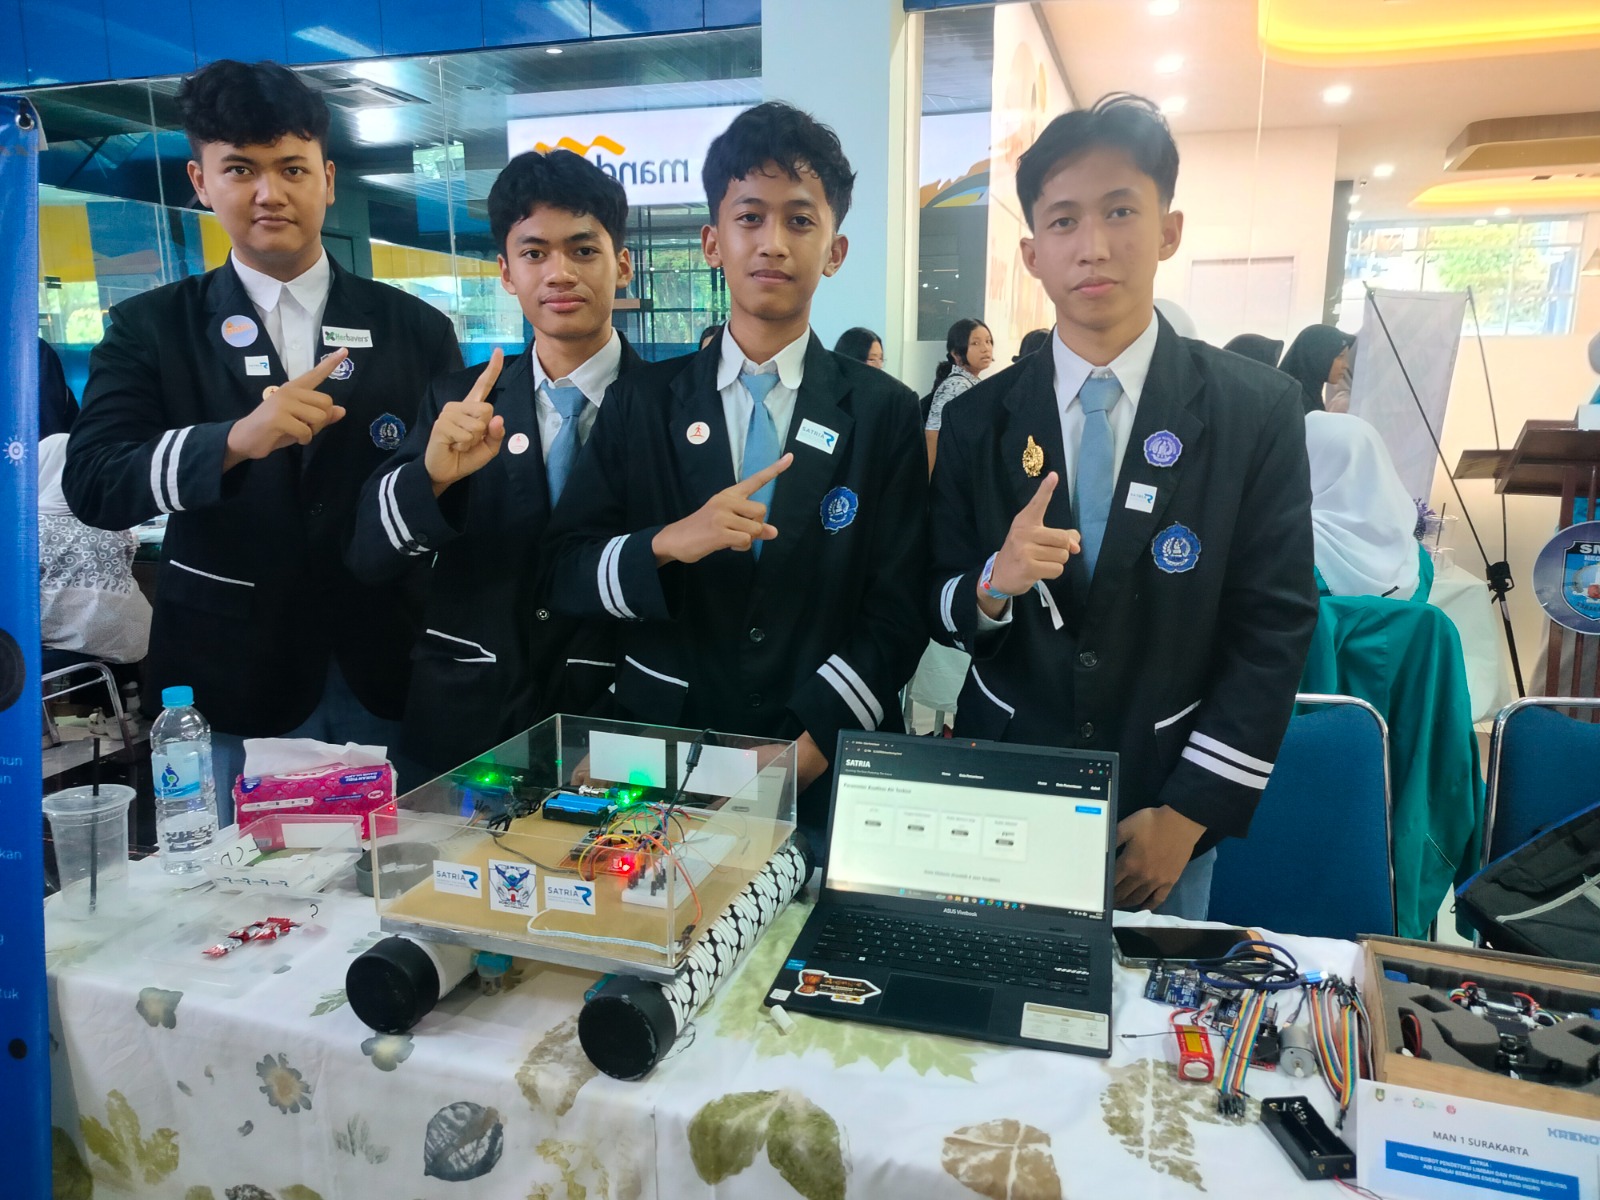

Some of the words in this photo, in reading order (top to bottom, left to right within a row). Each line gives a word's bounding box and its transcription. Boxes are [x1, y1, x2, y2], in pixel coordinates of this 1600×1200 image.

[802, 426, 825, 439] SATRIA
[845, 759, 871, 768] SATRIA
[436, 870, 466, 881] SATRIA
[547, 886, 579, 897] SATRIA
[1547, 1127, 1600, 1145] KRENO
[1433, 1130, 1457, 1142] MAN
[1460, 1136, 1465, 1144] 1
[1468, 1137, 1530, 1157] SURAKARTA
